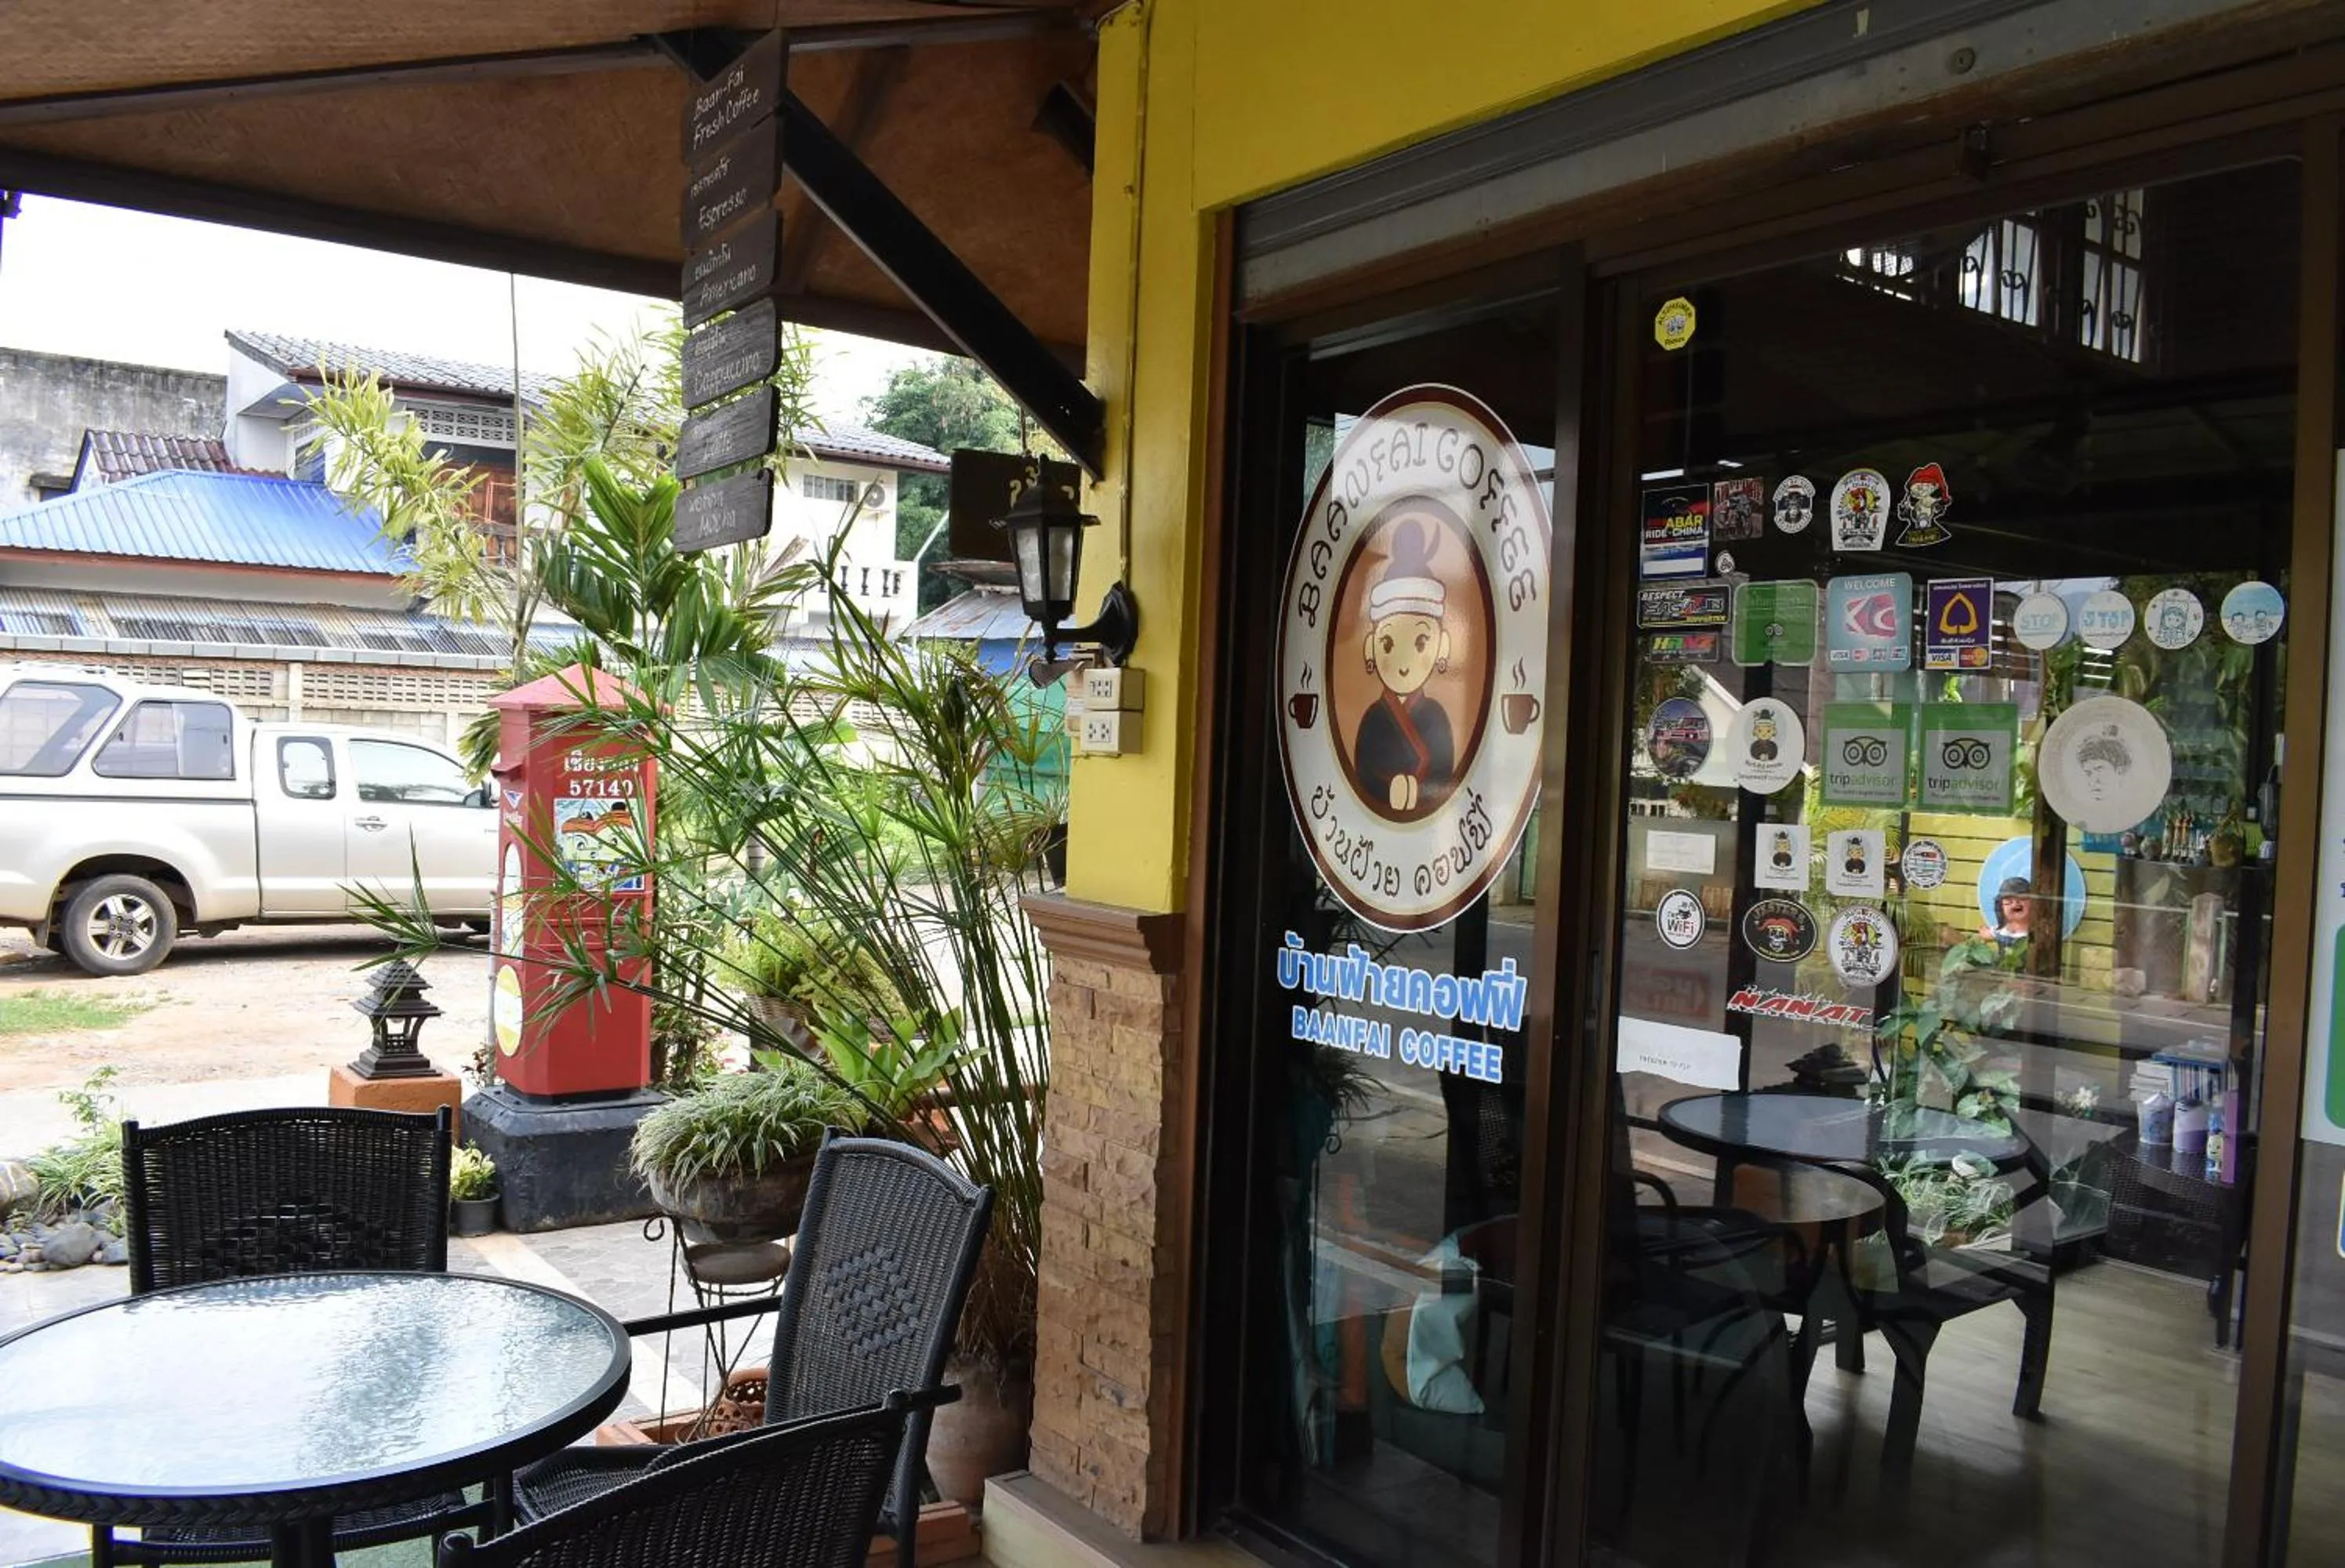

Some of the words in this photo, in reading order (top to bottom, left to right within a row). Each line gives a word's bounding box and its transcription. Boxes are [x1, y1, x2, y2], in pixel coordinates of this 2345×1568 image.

[694, 111, 724, 150] Fresh
[726, 88, 760, 124] Coffee
[699, 187, 747, 230] Espresso
[1298, 423, 1428, 627] BAANFAI
[1844, 578, 1897, 590] WELCOME
[1932, 653, 1951, 662] VISA
[570, 779, 633, 797] 57140
[1830, 771, 1896, 787] tripadvisor
[1928, 775, 1999, 792] tripadvisor
[1292, 1005, 1391, 1058] BAANFAI
[1399, 1027, 1503, 1083] COFFEE
